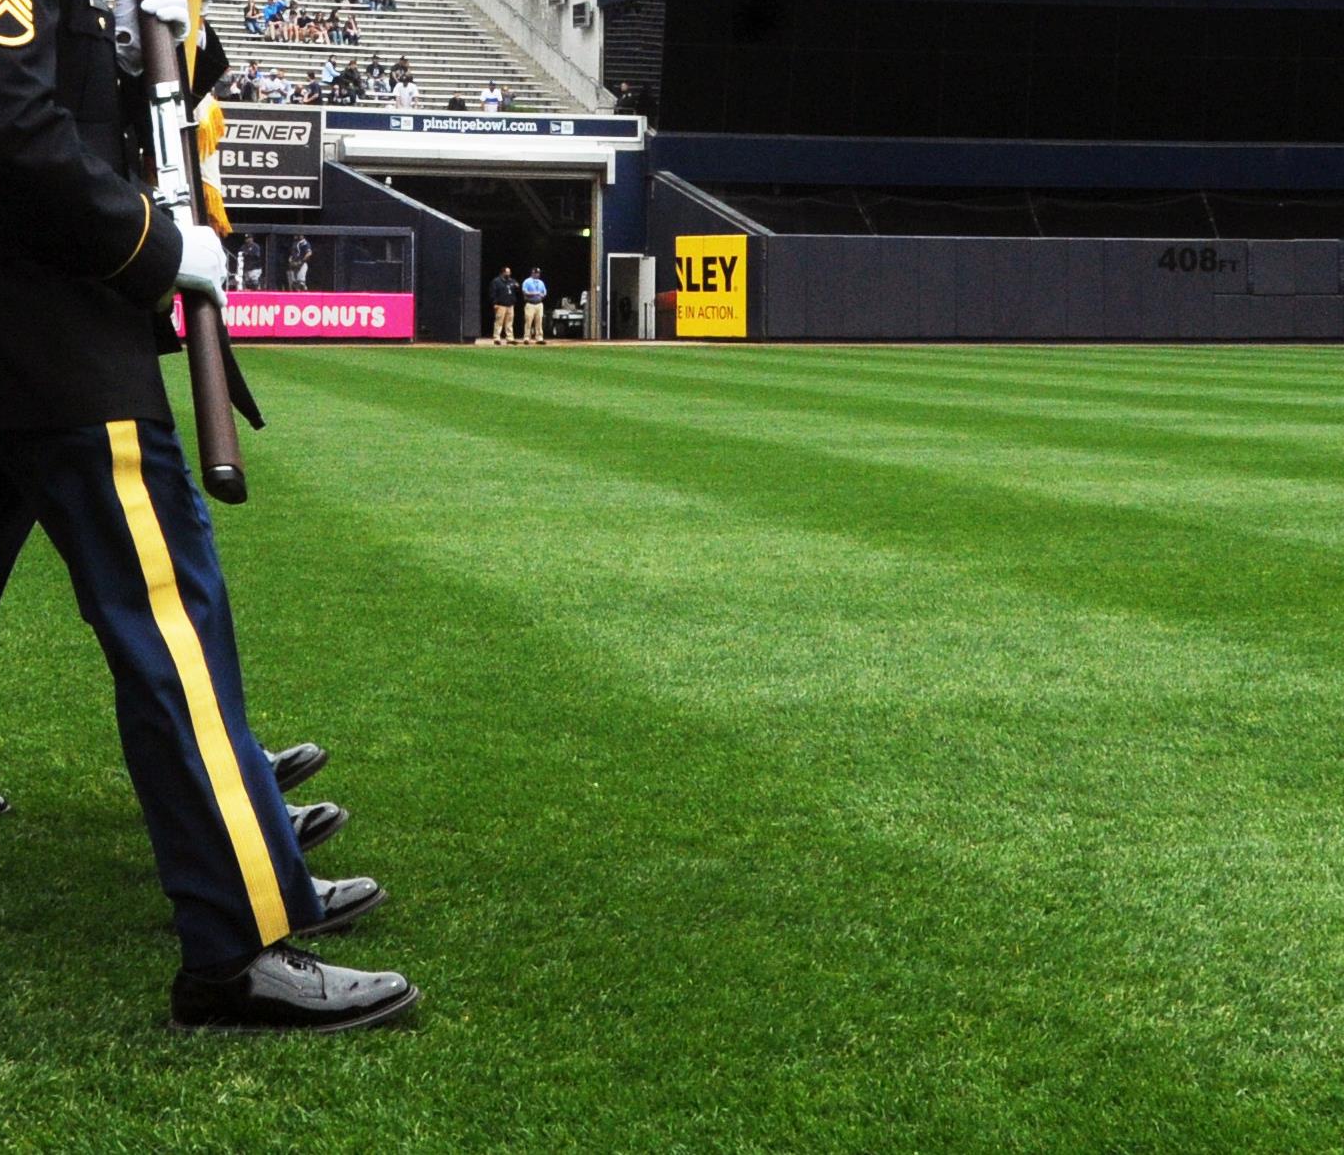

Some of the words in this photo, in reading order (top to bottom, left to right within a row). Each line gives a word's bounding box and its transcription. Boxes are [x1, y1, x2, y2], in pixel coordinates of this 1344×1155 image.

[224, 123, 307, 141] TEINER
[422, 116, 538, 133] pinstripebowl.com
[222, 304, 279, 326] NKIN'
[283, 304, 386, 328] DONUTS
